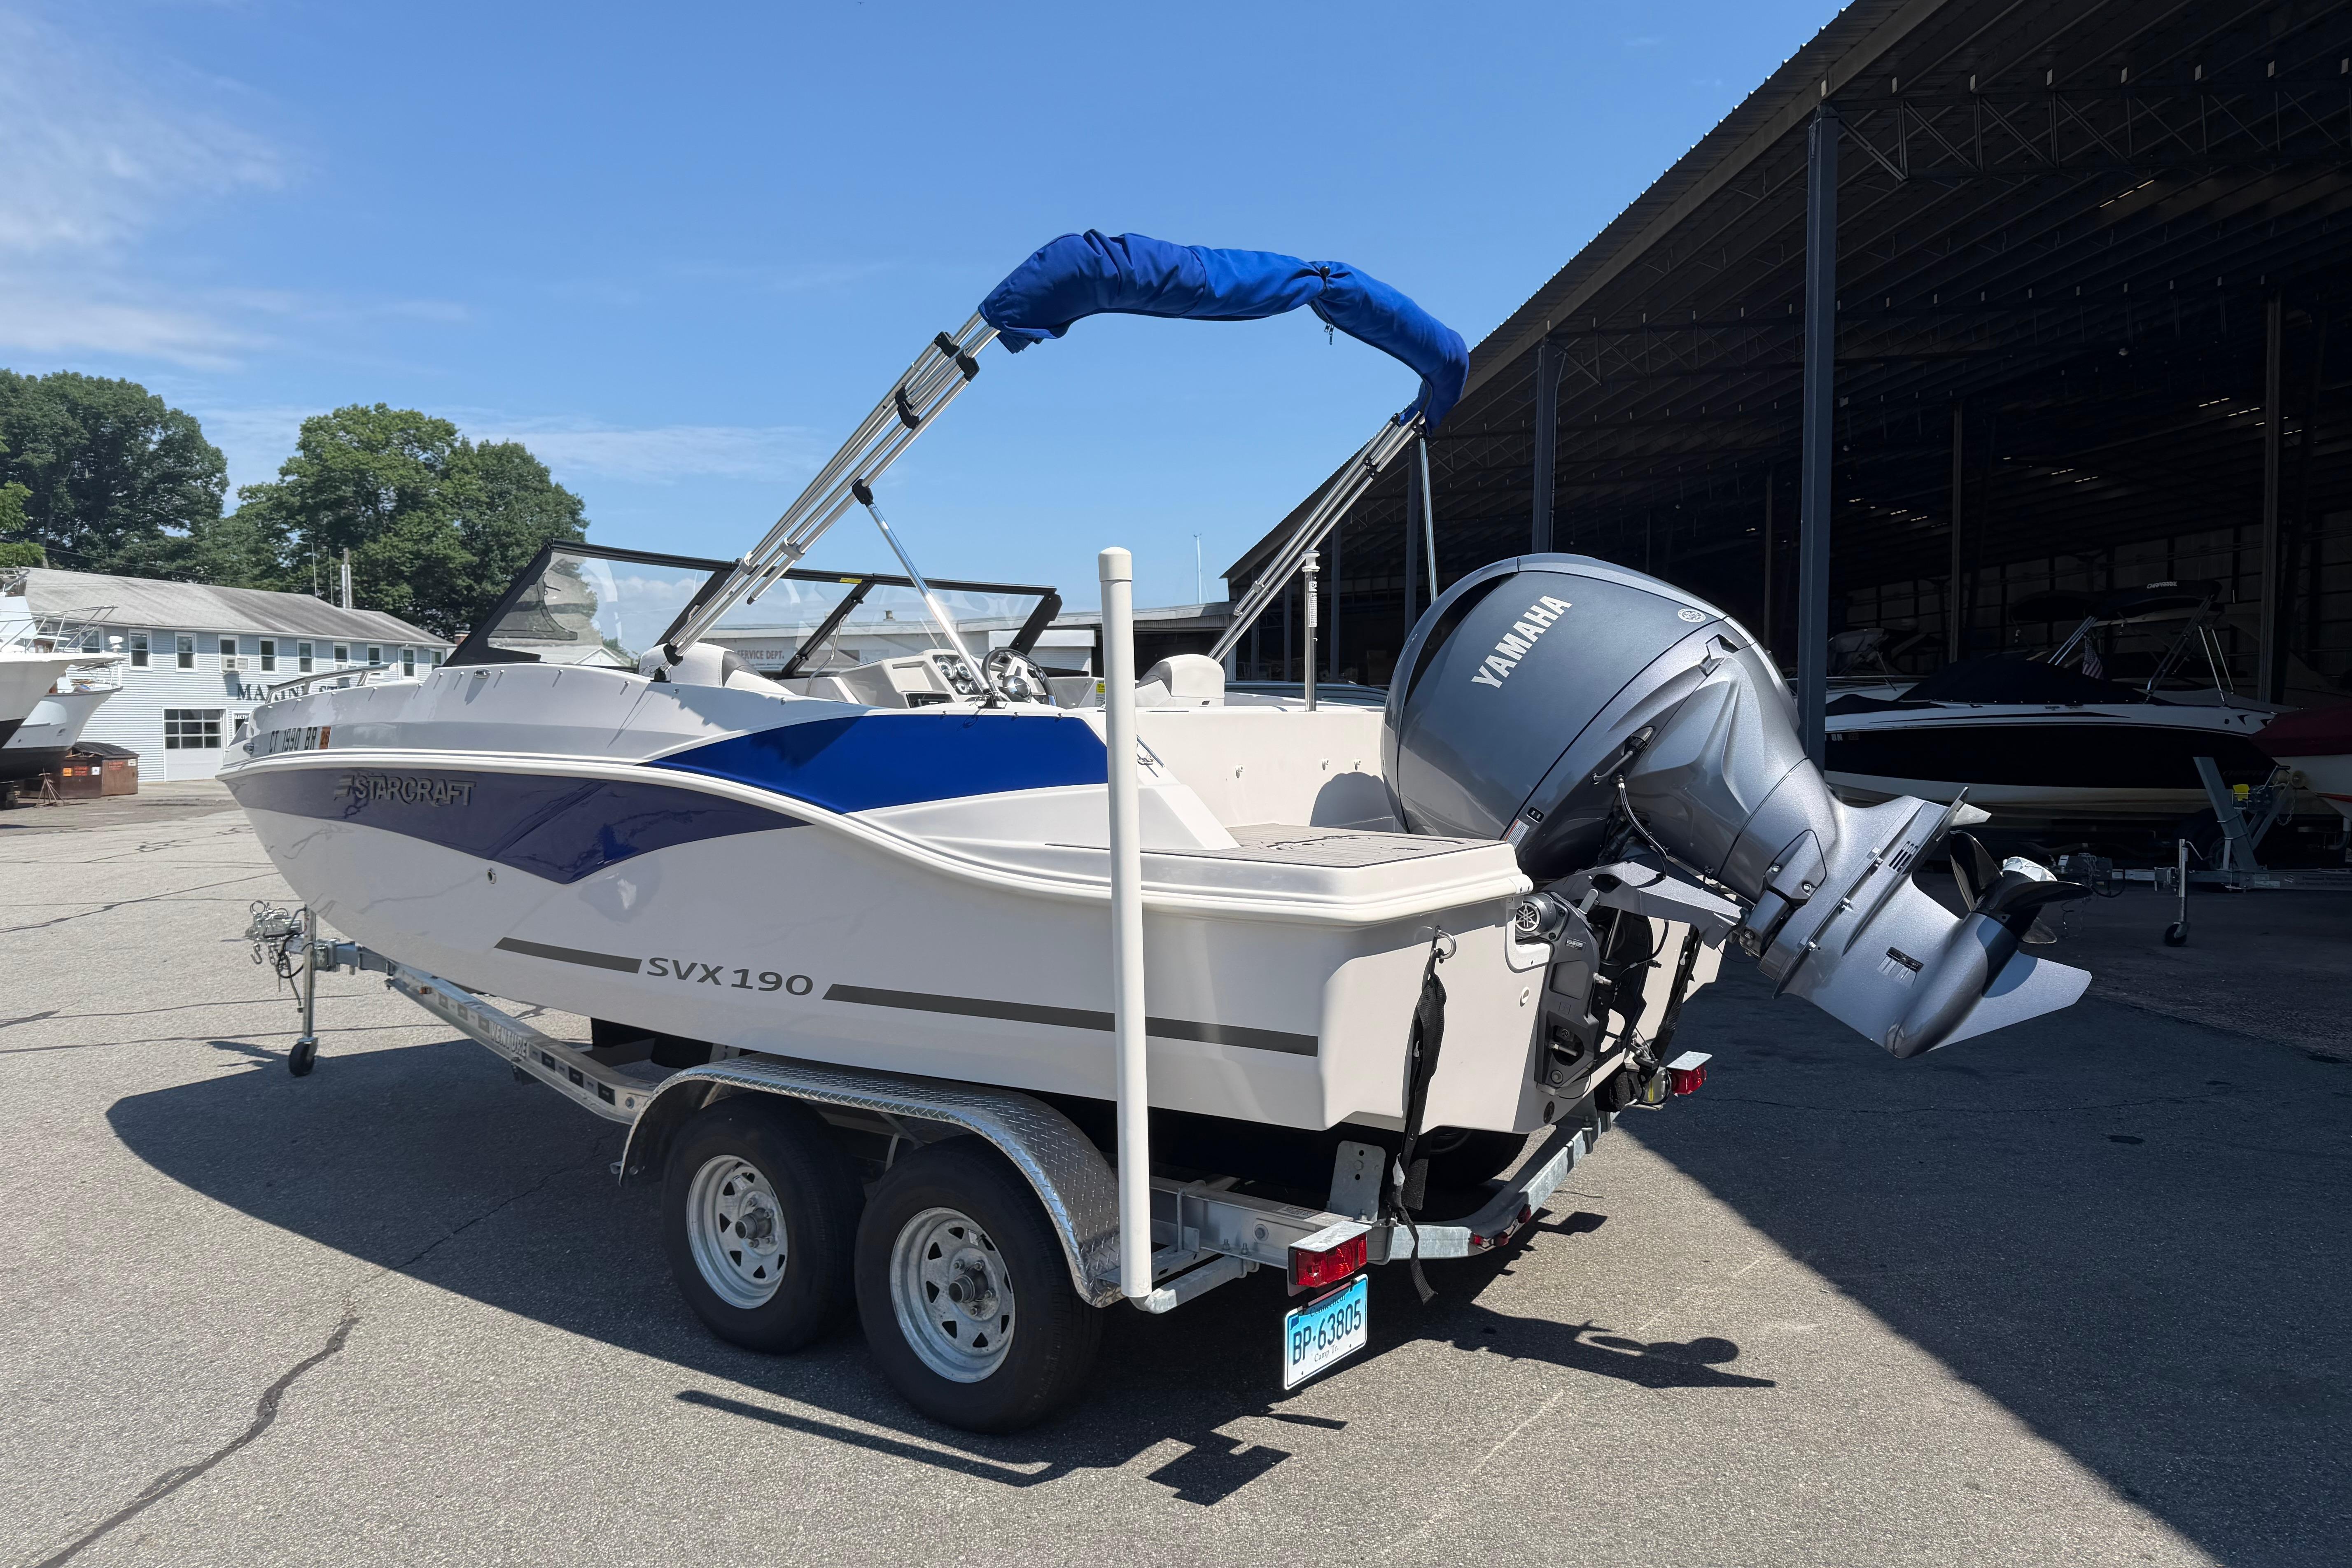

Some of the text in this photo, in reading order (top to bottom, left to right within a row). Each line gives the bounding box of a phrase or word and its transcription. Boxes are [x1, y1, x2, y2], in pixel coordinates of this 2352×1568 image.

[766, 650, 784, 659] DEPT.
[1471, 596, 1573, 688] YAMAHA
[269, 727, 317, 754] CT 1990 BR
[353, 775, 477, 807] STARCRAFT
[647, 957, 813, 996] SVX 190
[490, 1020, 527, 1059] VENTURE
[1310, 1294, 1346, 1317] Connecticut
[1314, 1350, 1330, 1362] Camp
